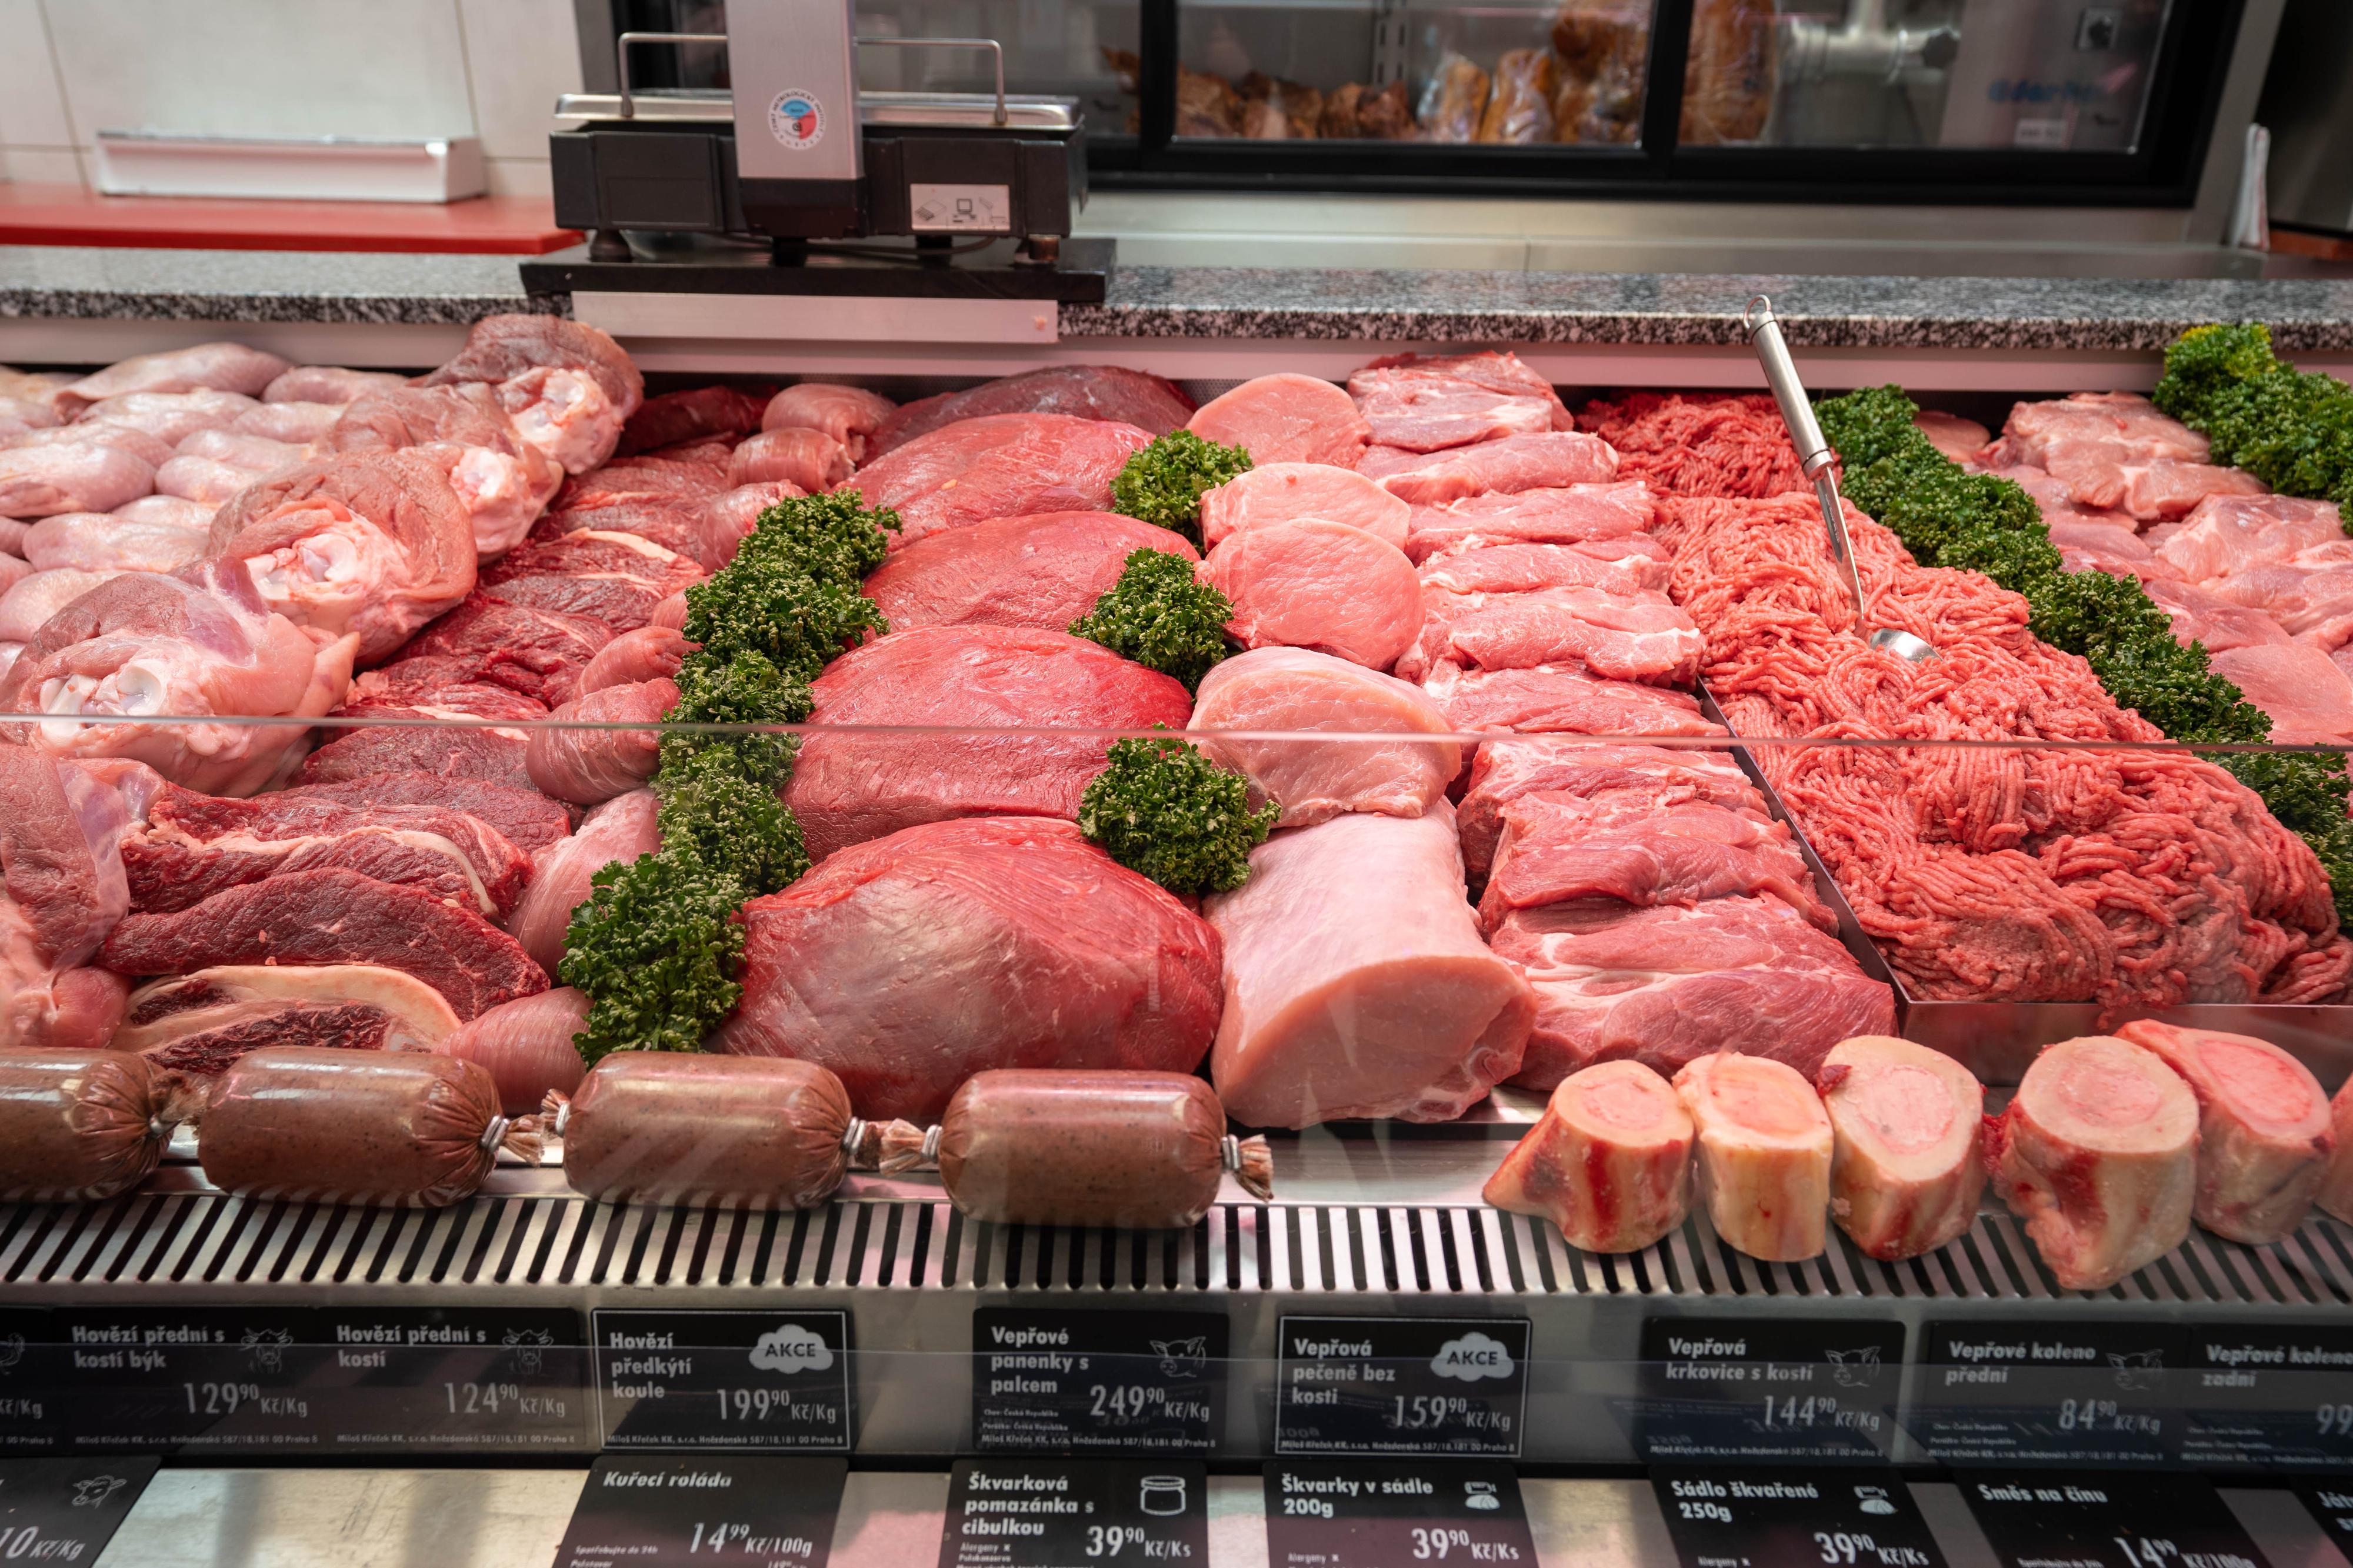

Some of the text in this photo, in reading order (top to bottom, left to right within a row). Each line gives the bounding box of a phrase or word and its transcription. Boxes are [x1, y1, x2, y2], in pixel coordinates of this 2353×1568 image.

[72, 1325, 225, 1347] Hovězí přední s
[336, 1325, 486, 1346] Hovězí přední s
[609, 1332, 674, 1350] Hovězí
[991, 1326, 1069, 1348] Vepřové
[765, 1343, 816, 1357] AKCE
[1294, 1337, 1372, 1359] Vepřová
[1448, 1351, 1498, 1365] AKCE
[1668, 1337, 1747, 1359] Vepřová
[1949, 1341, 2097, 1363] Vepřové koleno
[2206, 1344, 2286, 1366] Vepřové
[74, 1350, 167, 1372] kostí býk
[338, 1350, 386, 1367] kostí
[991, 1352, 1089, 1373] panenky s
[1293, 1363, 1396, 1383] pečeně bez
[1665, 1363, 1813, 1381] krkovice s kostí
[1944, 1366, 2009, 1386] přední
[612, 1381, 665, 1399] koule
[991, 1375, 1058, 1396] palcem
[1292, 1387, 1338, 1404] kosti
[261, 1397, 308, 1417] Kč/Kg
[520, 1398, 565, 1417] Kč/Kg
[791, 1403, 836, 1424] Kč/Kg
[1164, 1402, 1210, 1422] Kč/Kg
[1466, 1410, 1511, 1431] Kč/Kg
[1834, 1412, 1880, 1432] Kč/Kg
[603, 1471, 732, 1488] Kuřecí roláda
[968, 1470, 1069, 1492] Škvarková
[1281, 1472, 1434, 1497] Škvarky v sádle
[1671, 1480, 1819, 1499] Sádlo škvařené
[1977, 1483, 2034, 1501] Směs
[2033, 1488, 2065, 1502] na
[965, 1497, 1095, 1516] pomazánka s
[1283, 1497, 1334, 1519] 200g
[1678, 1502, 1733, 1523] 250g
[961, 1518, 1045, 1536] cibulkou
[744, 1537, 813, 1559] Kč/100g
[1145, 1540, 1192, 1560] Kč/Ks
[1471, 1542, 1520, 1562] Kč/Ks
